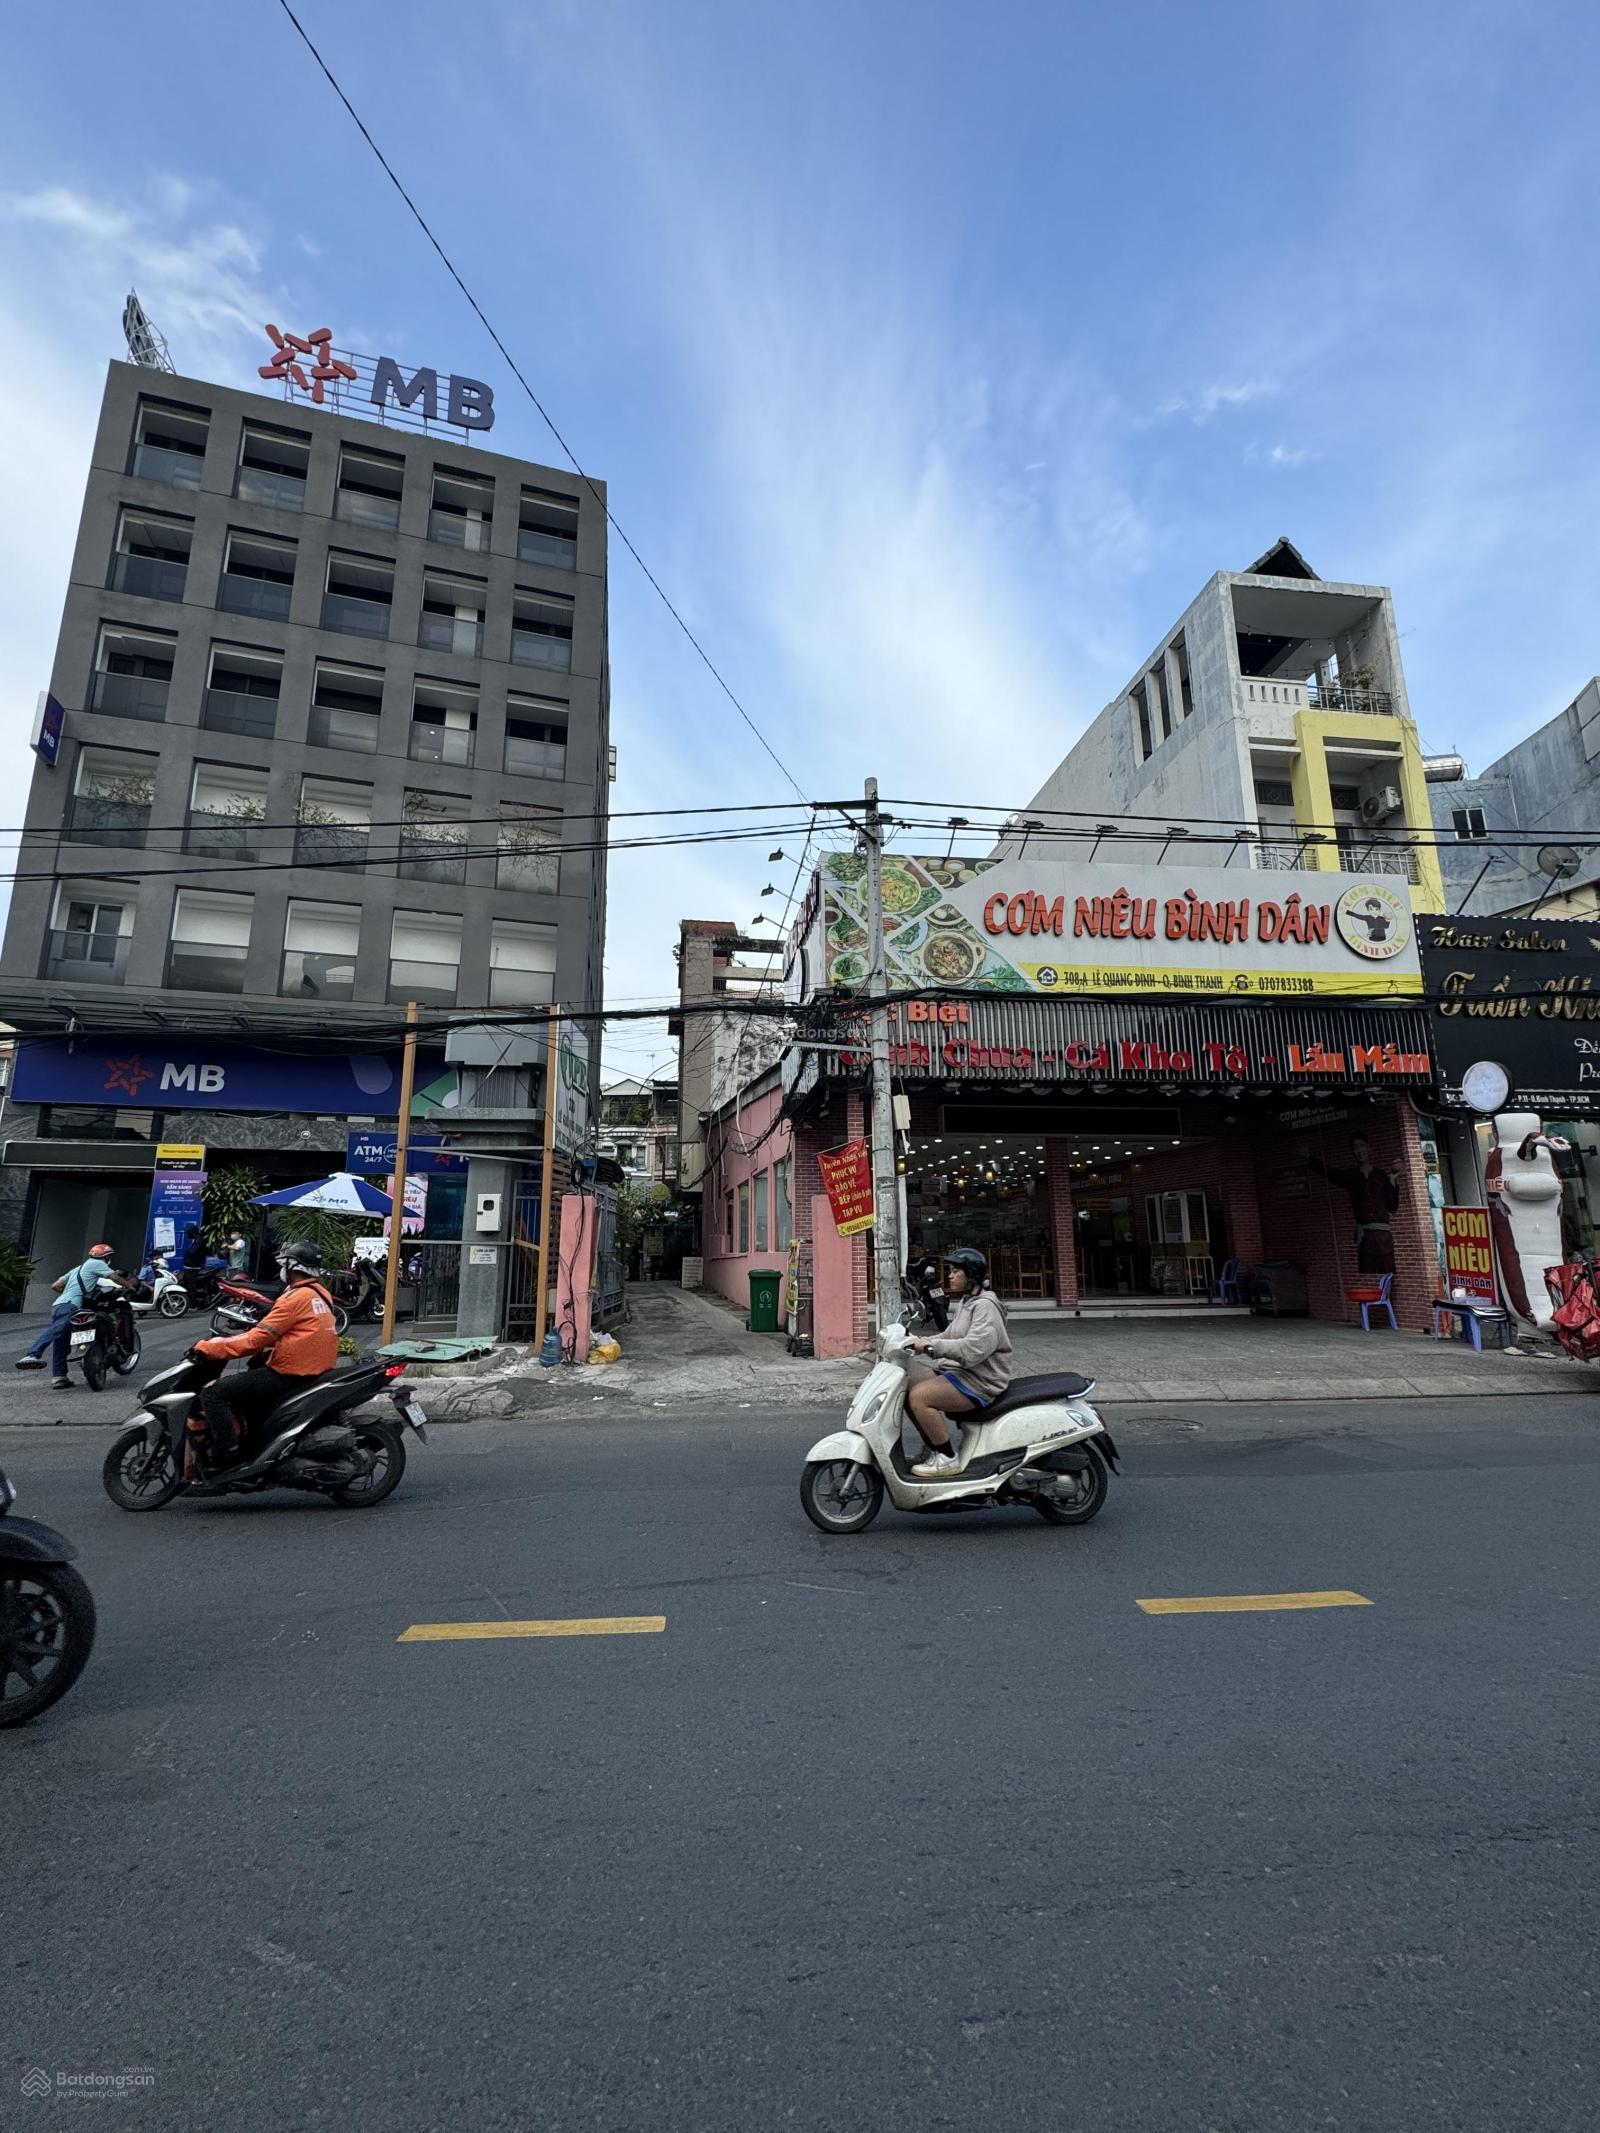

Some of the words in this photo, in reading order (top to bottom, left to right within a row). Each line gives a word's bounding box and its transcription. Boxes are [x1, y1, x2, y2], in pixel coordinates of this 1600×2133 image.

[370, 356, 496, 432] MB
[43, 729, 55, 748] MB
[983, 889, 1065, 936] CƠM
[1073, 886, 1157, 939] NIÊU
[1165, 887, 1250, 944] BÌNH
[1257, 892, 1330, 945] DÂN
[1430, 926, 1494, 948] Hair
[1500, 929, 1569, 951] Salon
[1103, 972, 1134, 988] QUANG
[1258, 976, 1315, 992] 0707833388
[907, 1001, 968, 1028] Biệt
[942, 1038, 1032, 1069] Chua
[1064, 1039, 1110, 1071] Cá
[1120, 1041, 1193, 1072] Kho
[1202, 1042, 1249, 1079] Tộ
[1288, 1043, 1345, 1074] Lẩu
[1353, 1043, 1430, 1074] Mắm
[160, 1063, 225, 1093] MB
[354, 1145, 383, 1156] ATM
[838, 1193, 851, 1206] BẾP
[1445, 1211, 1488, 1239] CƠM
[1449, 1242, 1490, 1273] NIÊU
